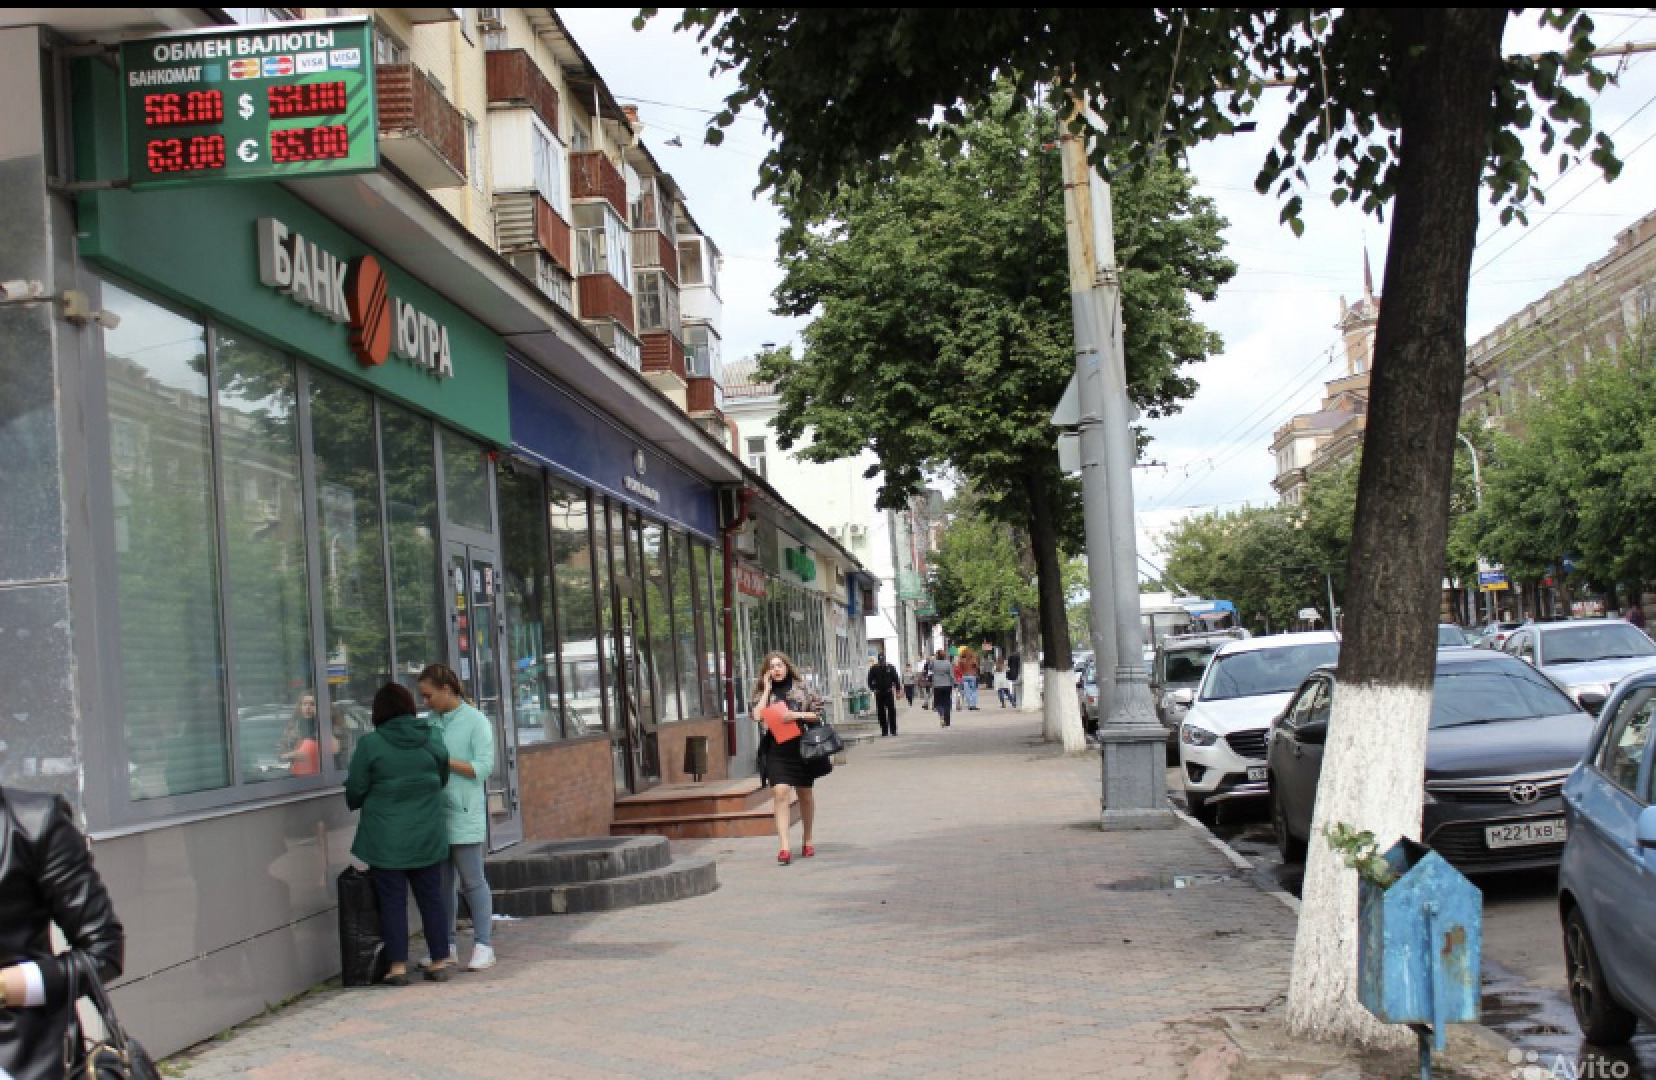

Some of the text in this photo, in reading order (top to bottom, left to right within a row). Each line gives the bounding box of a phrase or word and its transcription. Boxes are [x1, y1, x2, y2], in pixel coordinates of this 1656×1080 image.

[153, 30, 335, 62] ОБМЕН ВАЛЮТЫ
[129, 66, 202, 87] БАНКОМАТ
[144, 90, 223, 124] 56.00
[237, 93, 255, 120] $
[147, 134, 225, 173] 63.00
[236, 139, 259, 162] €
[258, 217, 351, 323] БАНК
[390, 297, 454, 379] ЮГРА
